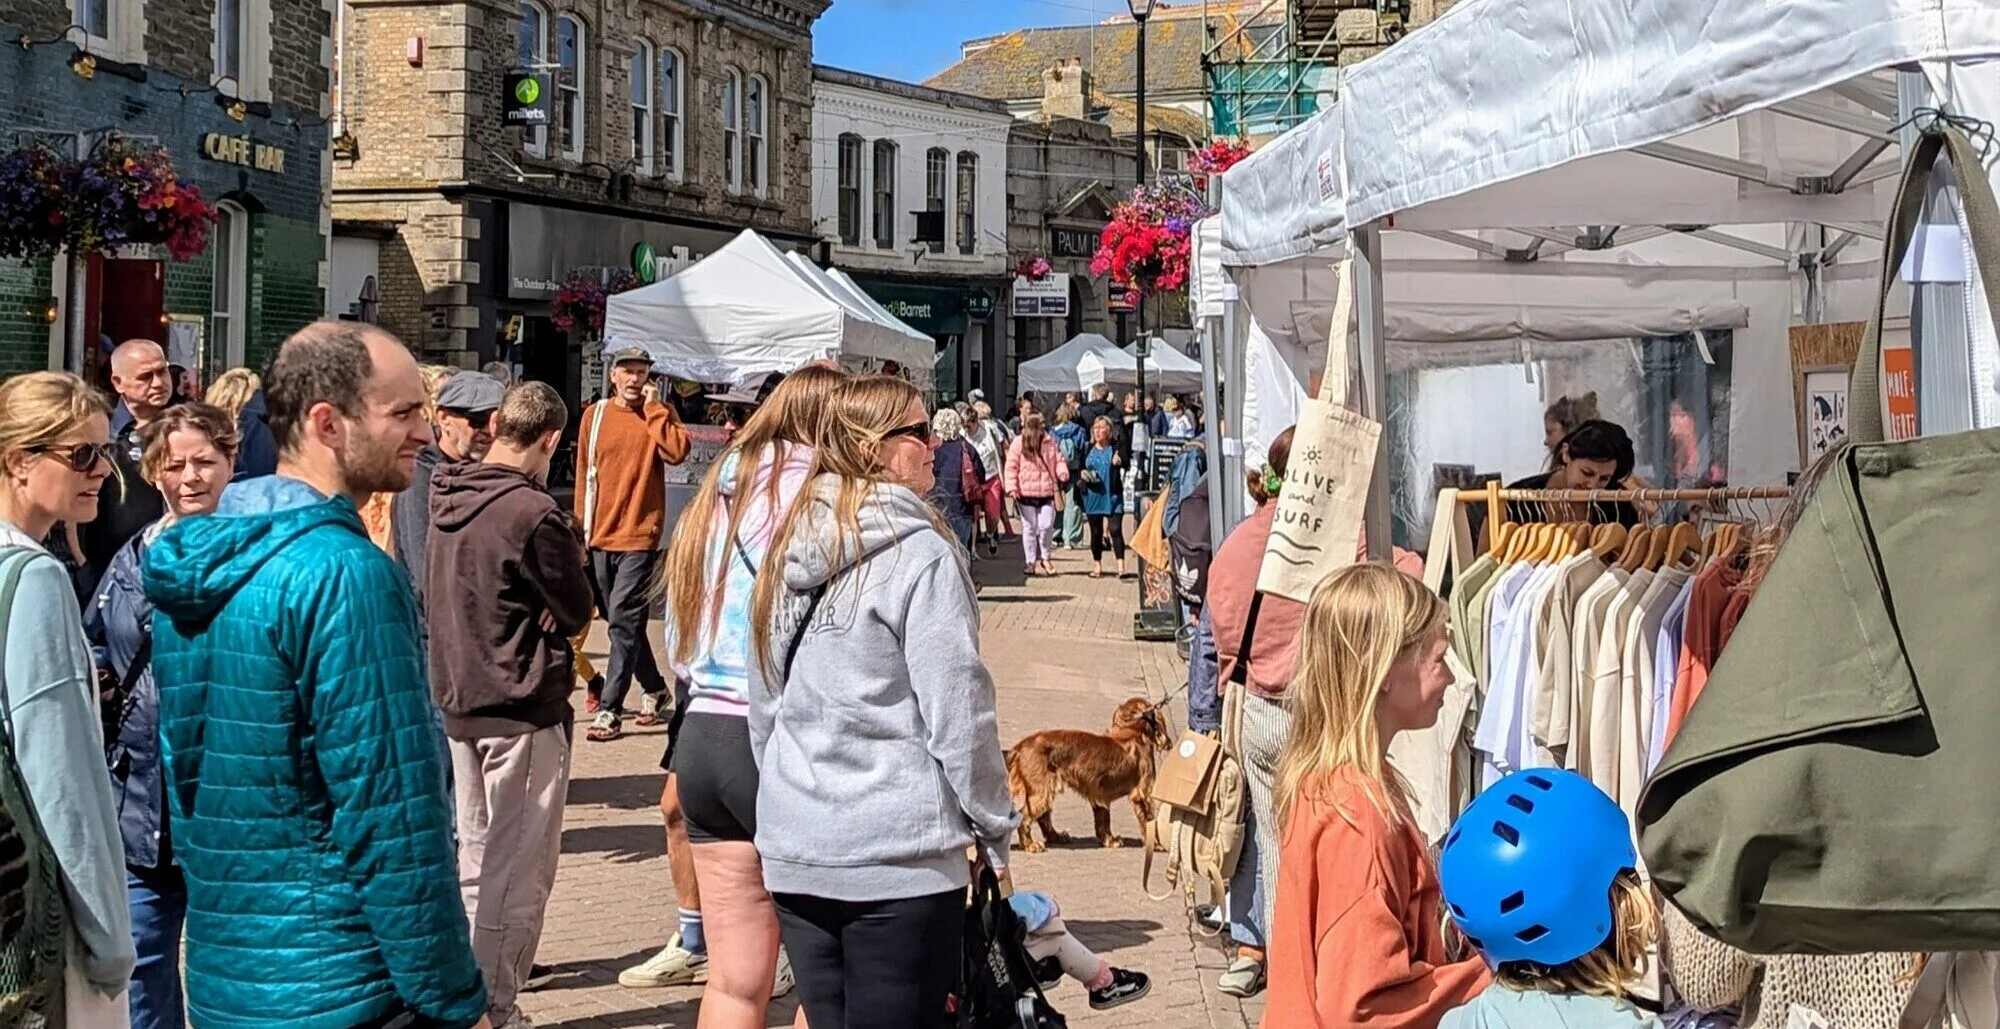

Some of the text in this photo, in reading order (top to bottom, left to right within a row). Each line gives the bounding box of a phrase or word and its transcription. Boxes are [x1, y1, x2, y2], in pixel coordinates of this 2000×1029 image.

[508, 108, 545, 121] millets
[204, 133, 285, 174] CAFÉ BAR
[1058, 231, 1087, 254] PALM
[512, 277, 523, 288] The
[523, 278, 546, 290] Outdoor
[900, 300, 931, 318] Barrett
[1287, 493, 1316, 506] and
[1274, 507, 1324, 533] SURF
